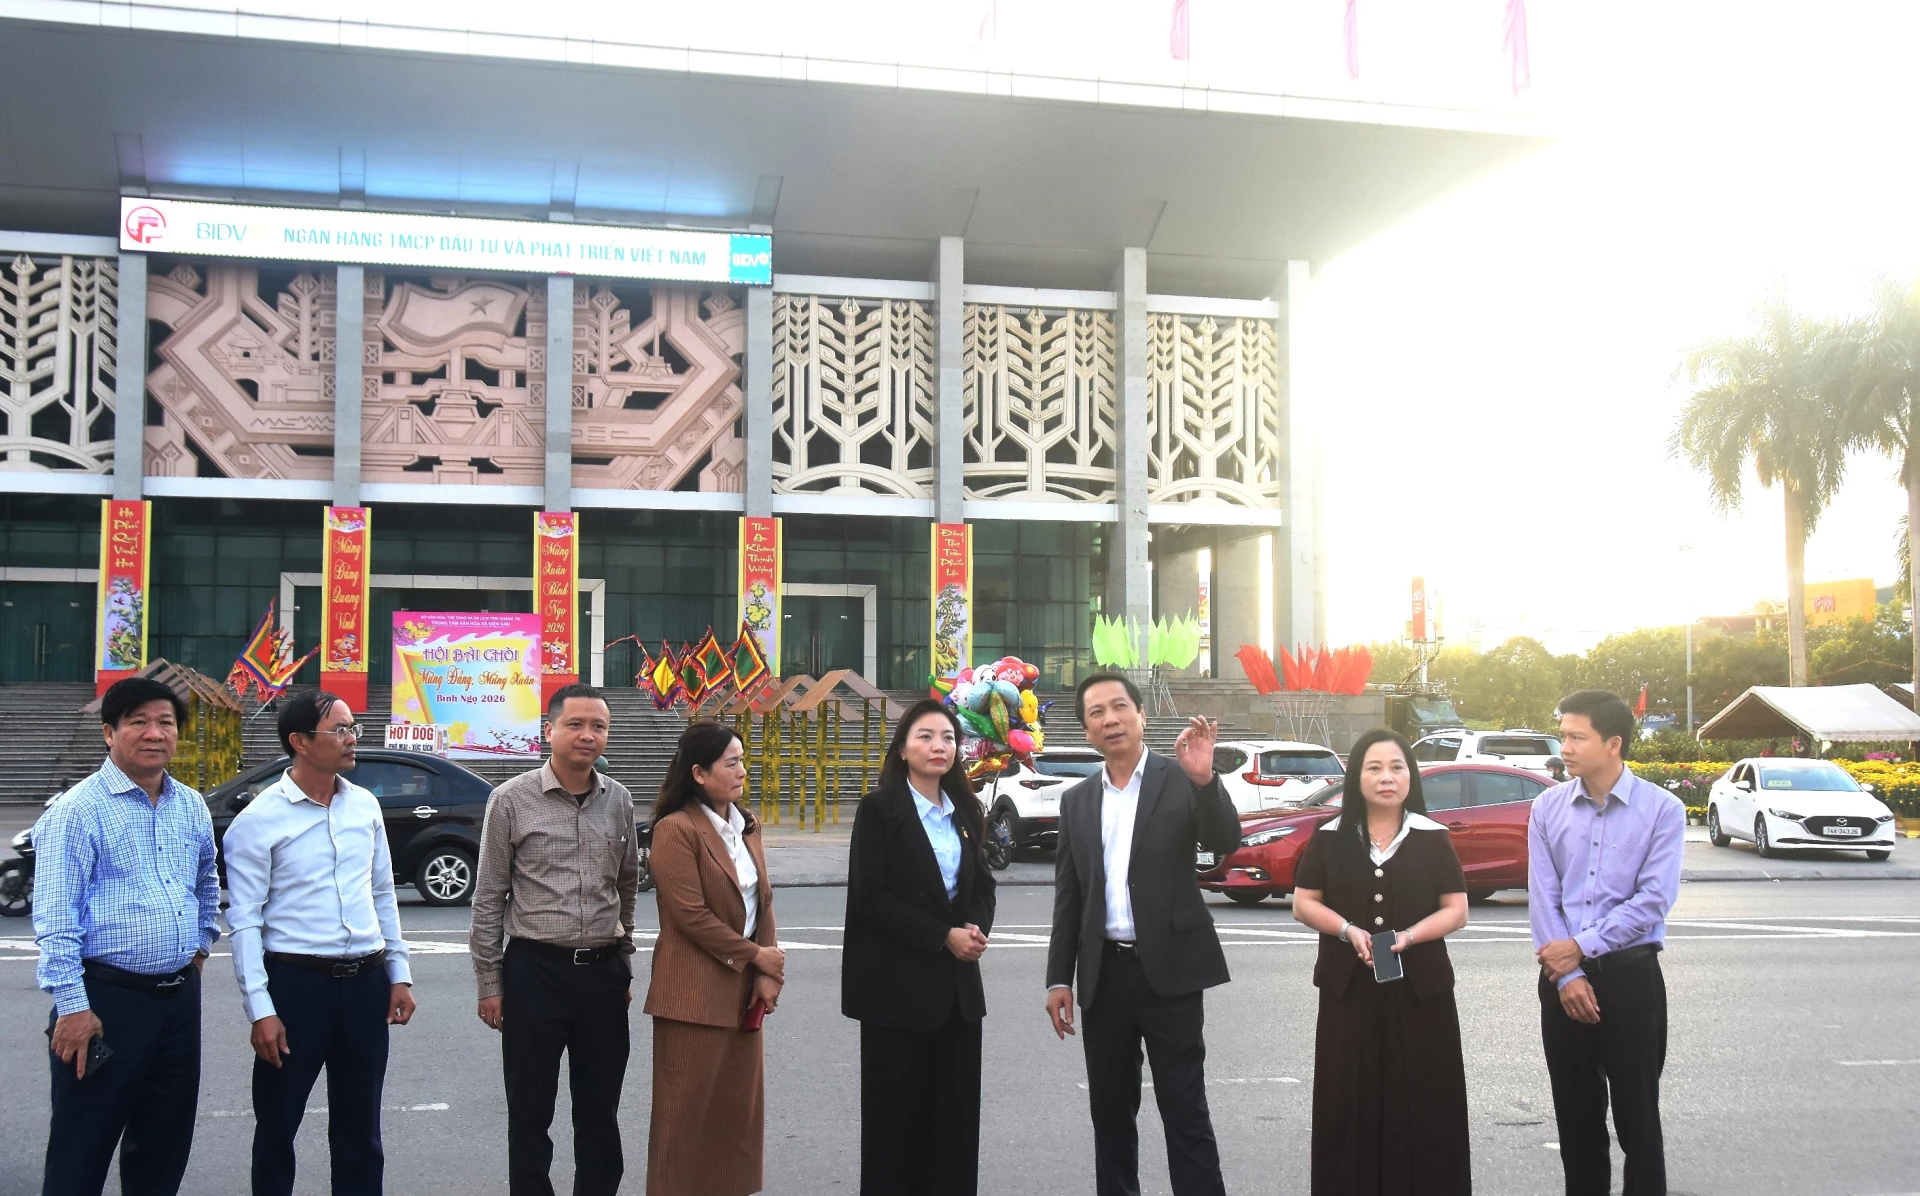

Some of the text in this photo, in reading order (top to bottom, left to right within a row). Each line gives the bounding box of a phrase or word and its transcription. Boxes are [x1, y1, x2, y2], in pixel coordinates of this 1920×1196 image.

[196, 222, 247, 242] BIDV
[389, 234, 434, 250] TMCP
[669, 251, 706, 267] NAM
[753, 533, 767, 542] An
[333, 536, 361, 560] Mừng
[541, 541, 570, 561] Mừng
[746, 544, 776, 558] Khang
[115, 557, 135, 568] Hoa
[542, 561, 567, 575] Xuân
[334, 559, 360, 587] Đảng
[332, 585, 360, 610] Quang
[545, 599, 567, 620] Ngọ
[335, 612, 356, 630] Vinh
[545, 623, 565, 633] 2026
[423, 646, 519, 663] HỘI BÀI CHÒI
[416, 665, 535, 691] Mừng Đảng, Mừng Xuân
[460, 694, 478, 704] Ngọ
[481, 694, 506, 703] 2026
[389, 726, 409, 740] HOT
[412, 727, 434, 741] DOG
